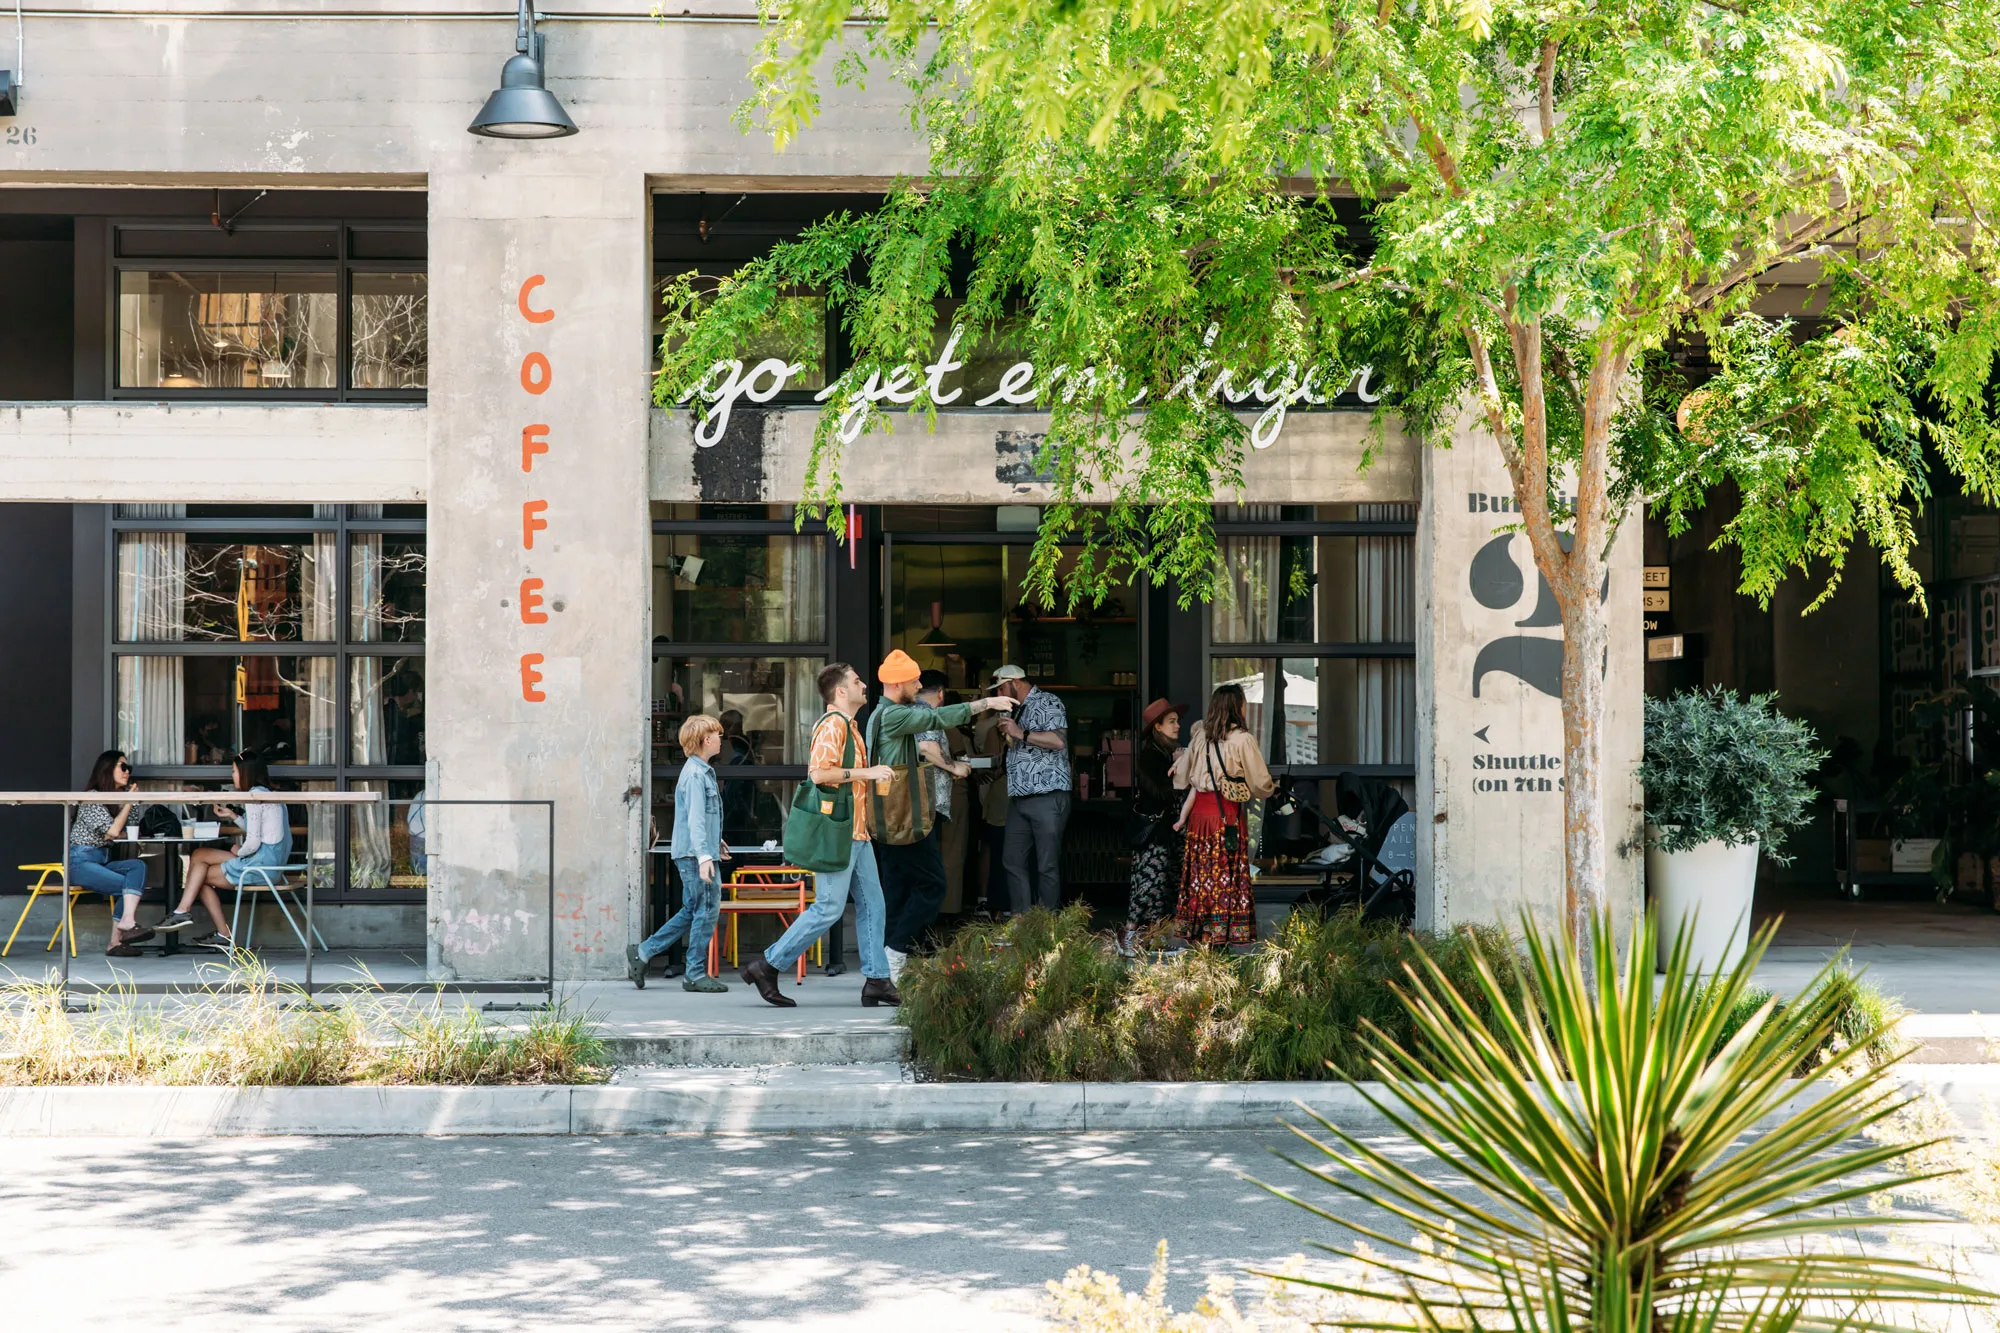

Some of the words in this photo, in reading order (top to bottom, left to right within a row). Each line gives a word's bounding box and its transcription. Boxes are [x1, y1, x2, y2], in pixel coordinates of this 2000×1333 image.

[6, 126, 37, 145] 26
[677, 358, 806, 448] go
[814, 323, 965, 444] get
[518, 274, 555, 702] COFFEE
[1642, 572, 1666, 582] EET
[1472, 754, 1561, 770] Shuttle
[1472, 776, 1509, 795] (on
[1514, 776, 1553, 792] 7th
[1393, 823, 1416, 832] PEN
[1384, 835, 1416, 844] AIL
